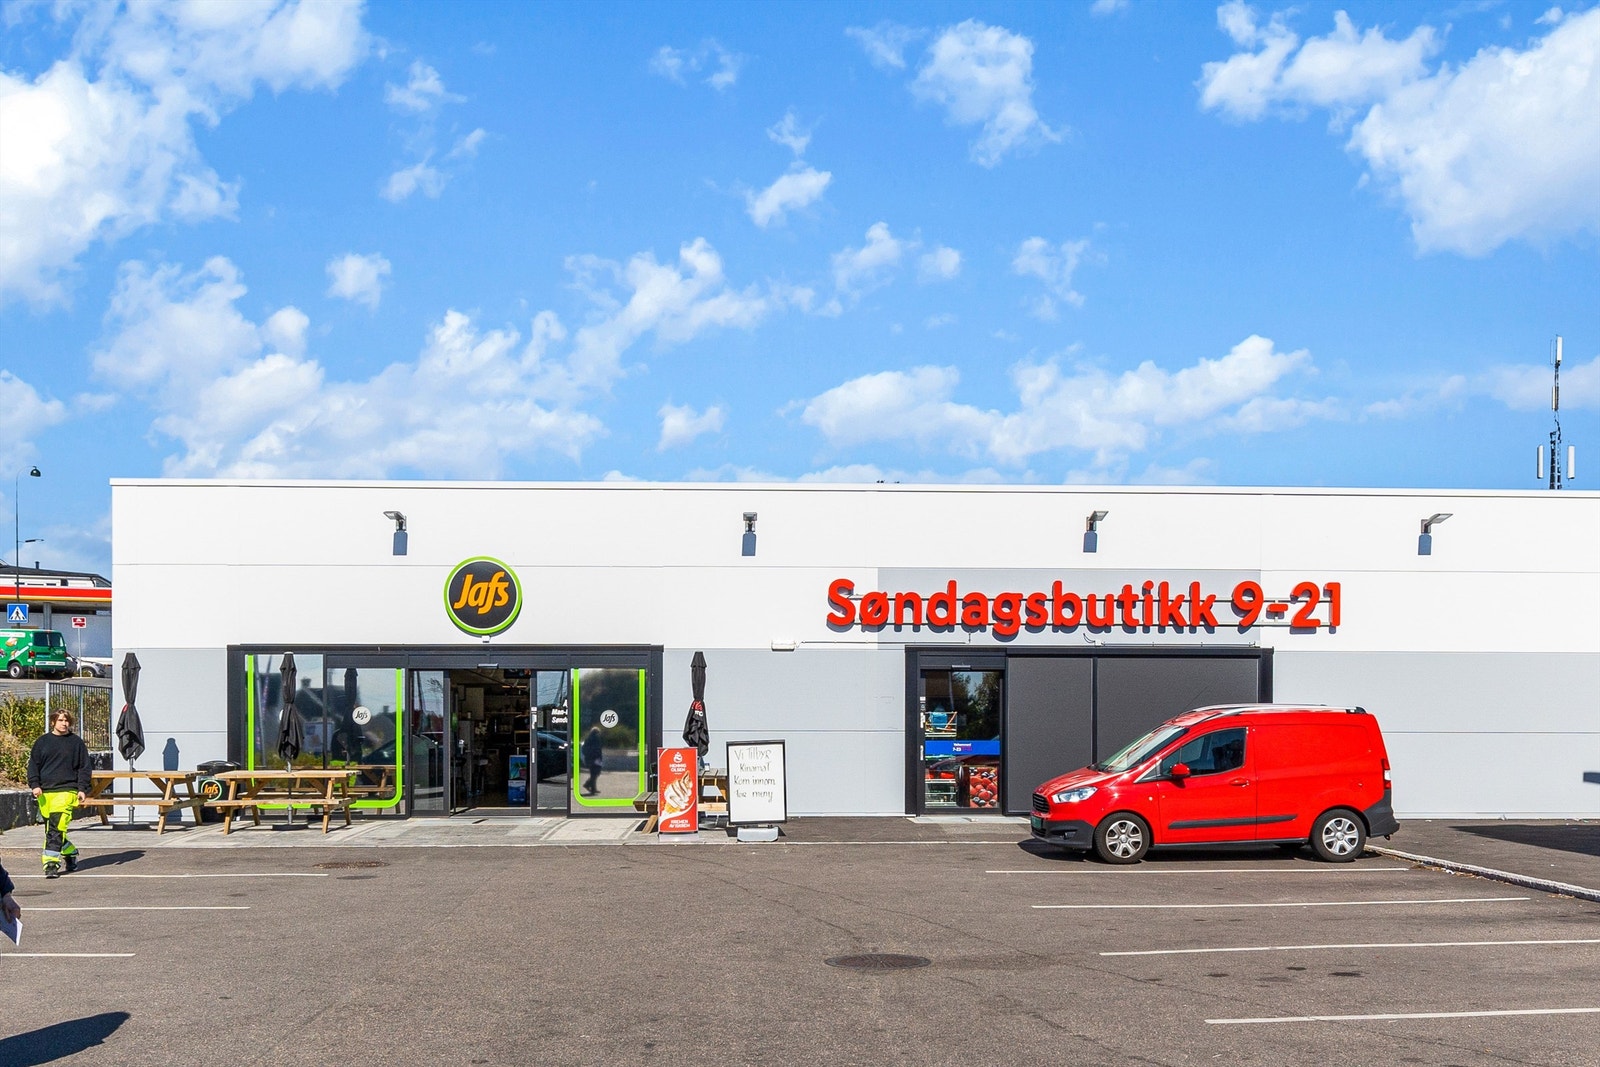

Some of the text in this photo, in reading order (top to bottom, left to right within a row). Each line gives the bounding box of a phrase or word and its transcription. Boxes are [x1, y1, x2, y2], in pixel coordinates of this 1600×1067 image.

[453, 571, 510, 614] Jafs
[826, 578, 1341, 636] Søndagsbutikk 9-21
[354, 710, 368, 721] Jafs
[602, 713, 616, 724] Jafs
[734, 749, 744, 760] Vi
[733, 775, 750, 785] Kom
